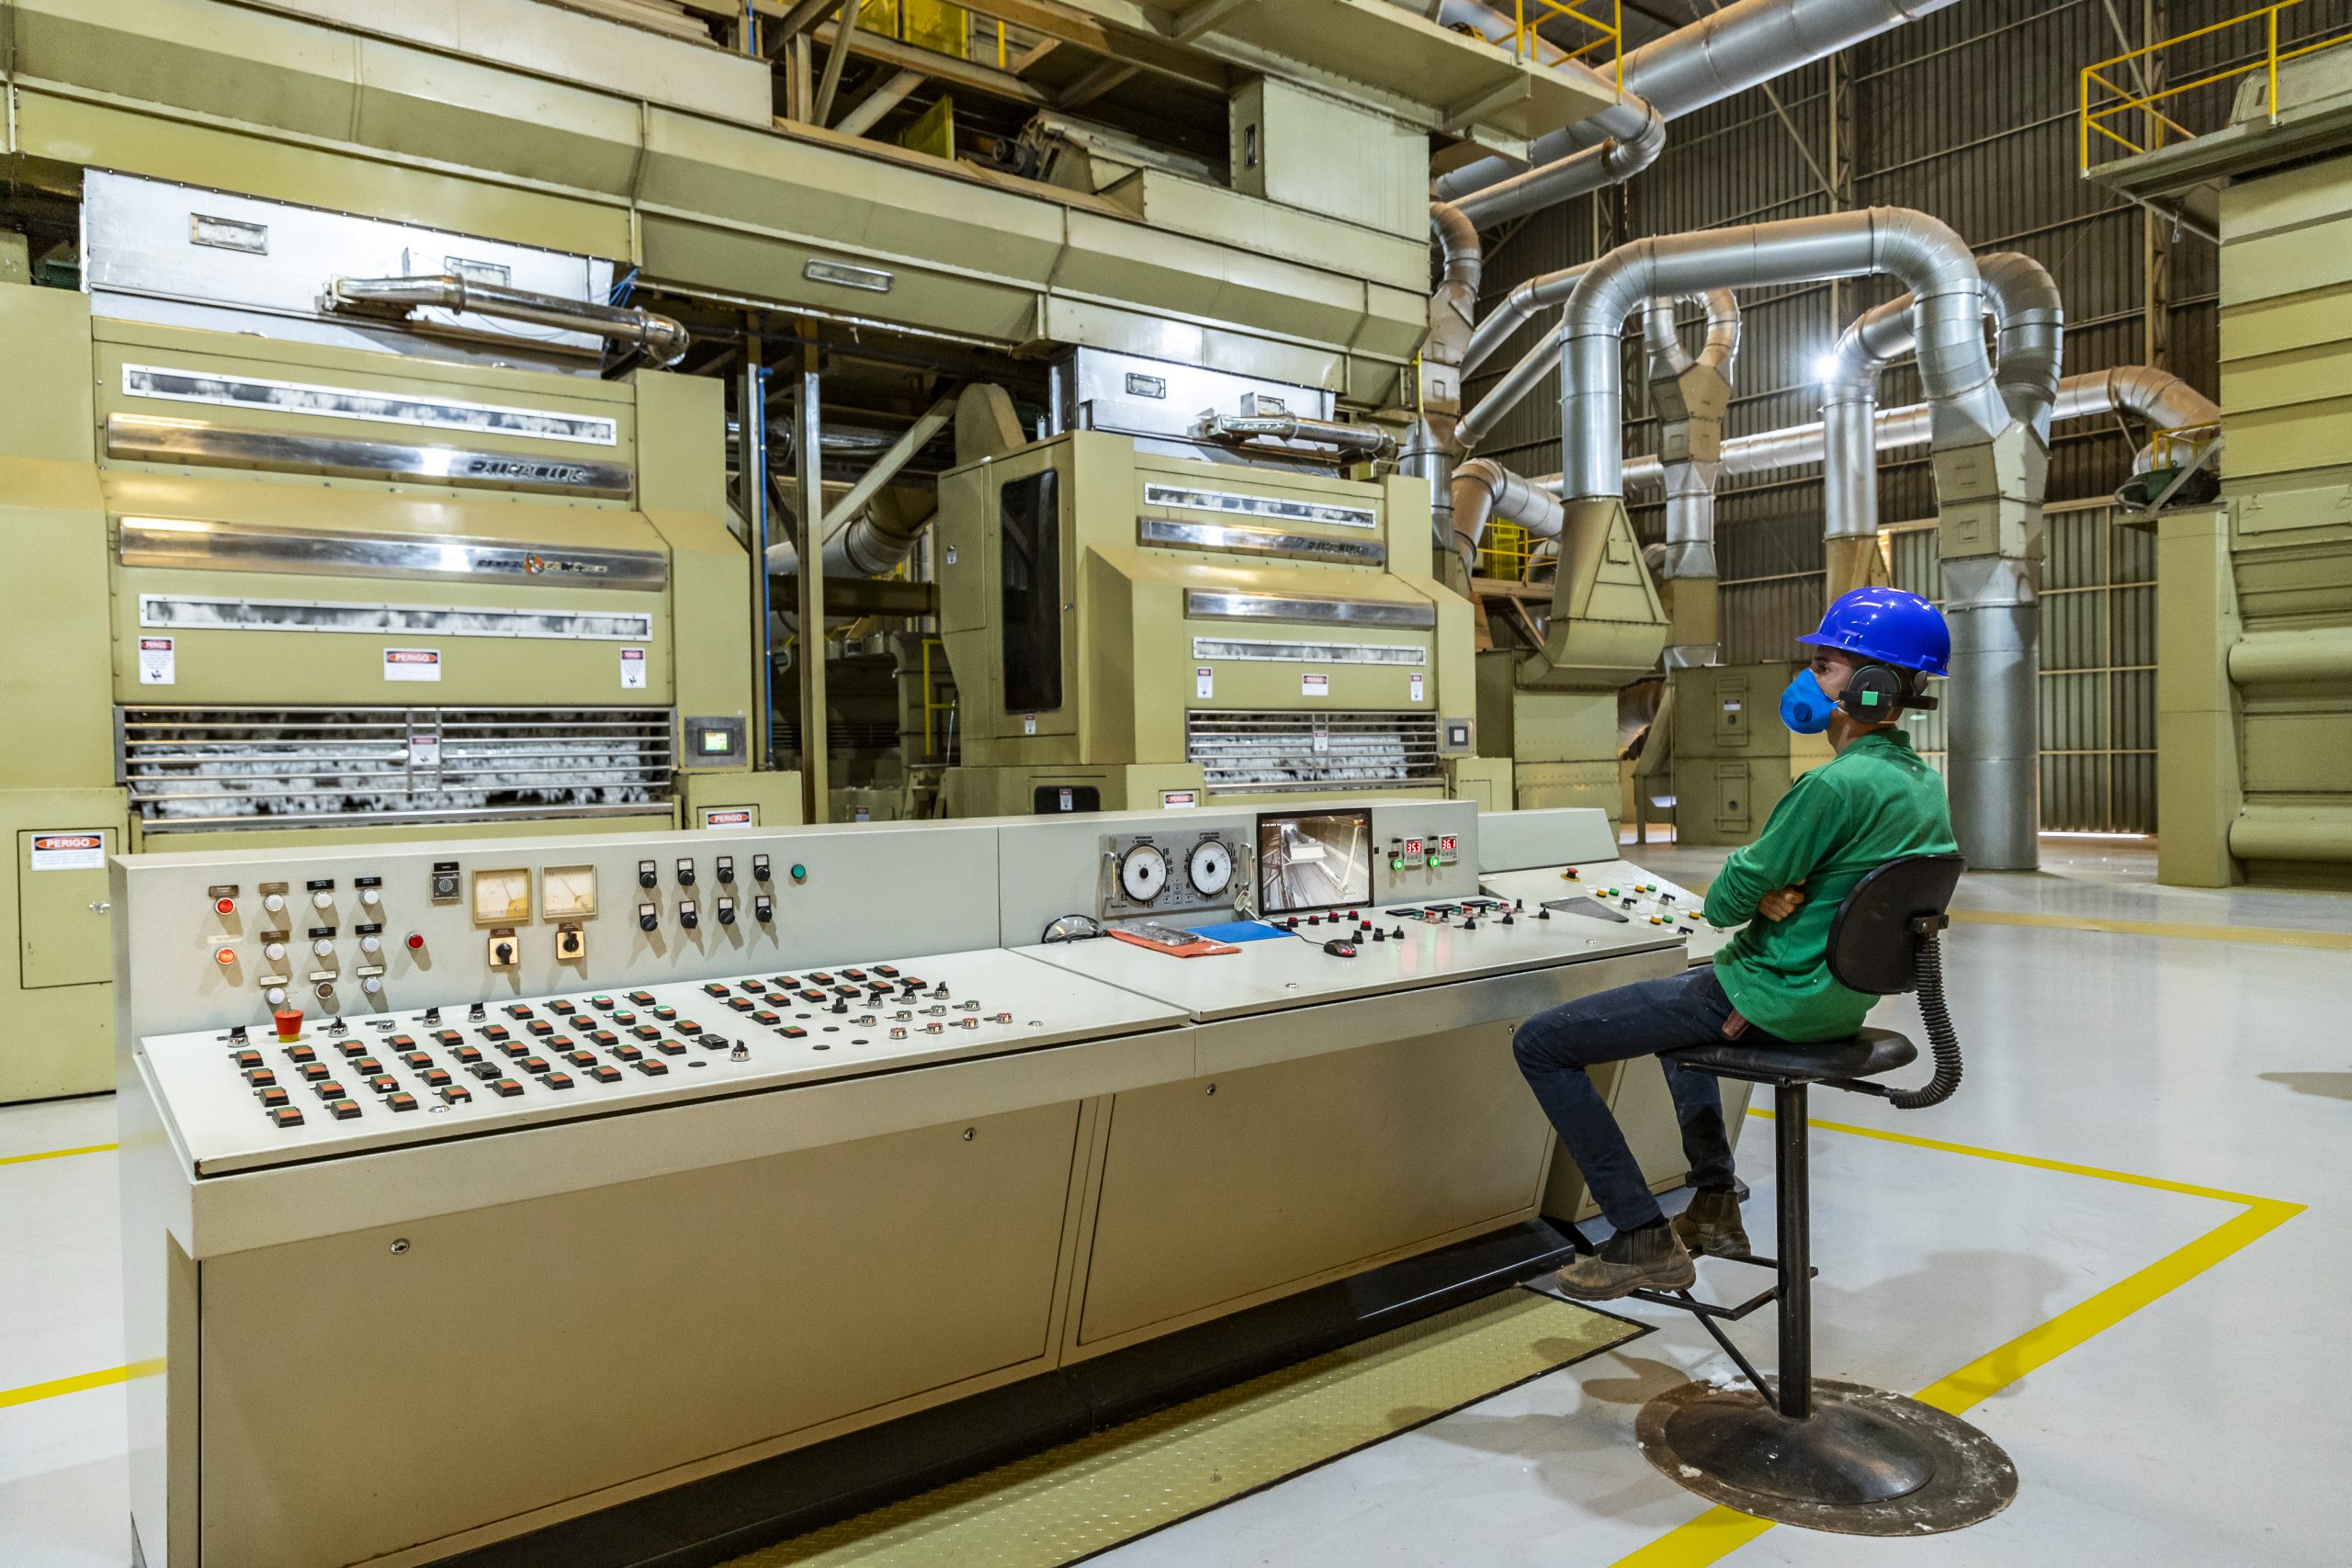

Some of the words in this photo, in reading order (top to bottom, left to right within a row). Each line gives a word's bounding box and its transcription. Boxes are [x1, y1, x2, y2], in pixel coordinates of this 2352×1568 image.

[395, 652, 430, 662] PERIGO
[714, 814, 743, 824] PERIGO
[46, 838, 91, 850] PERIGO
[1167, 867, 1174, 875] 15
[1164, 885, 1170, 893] 14
